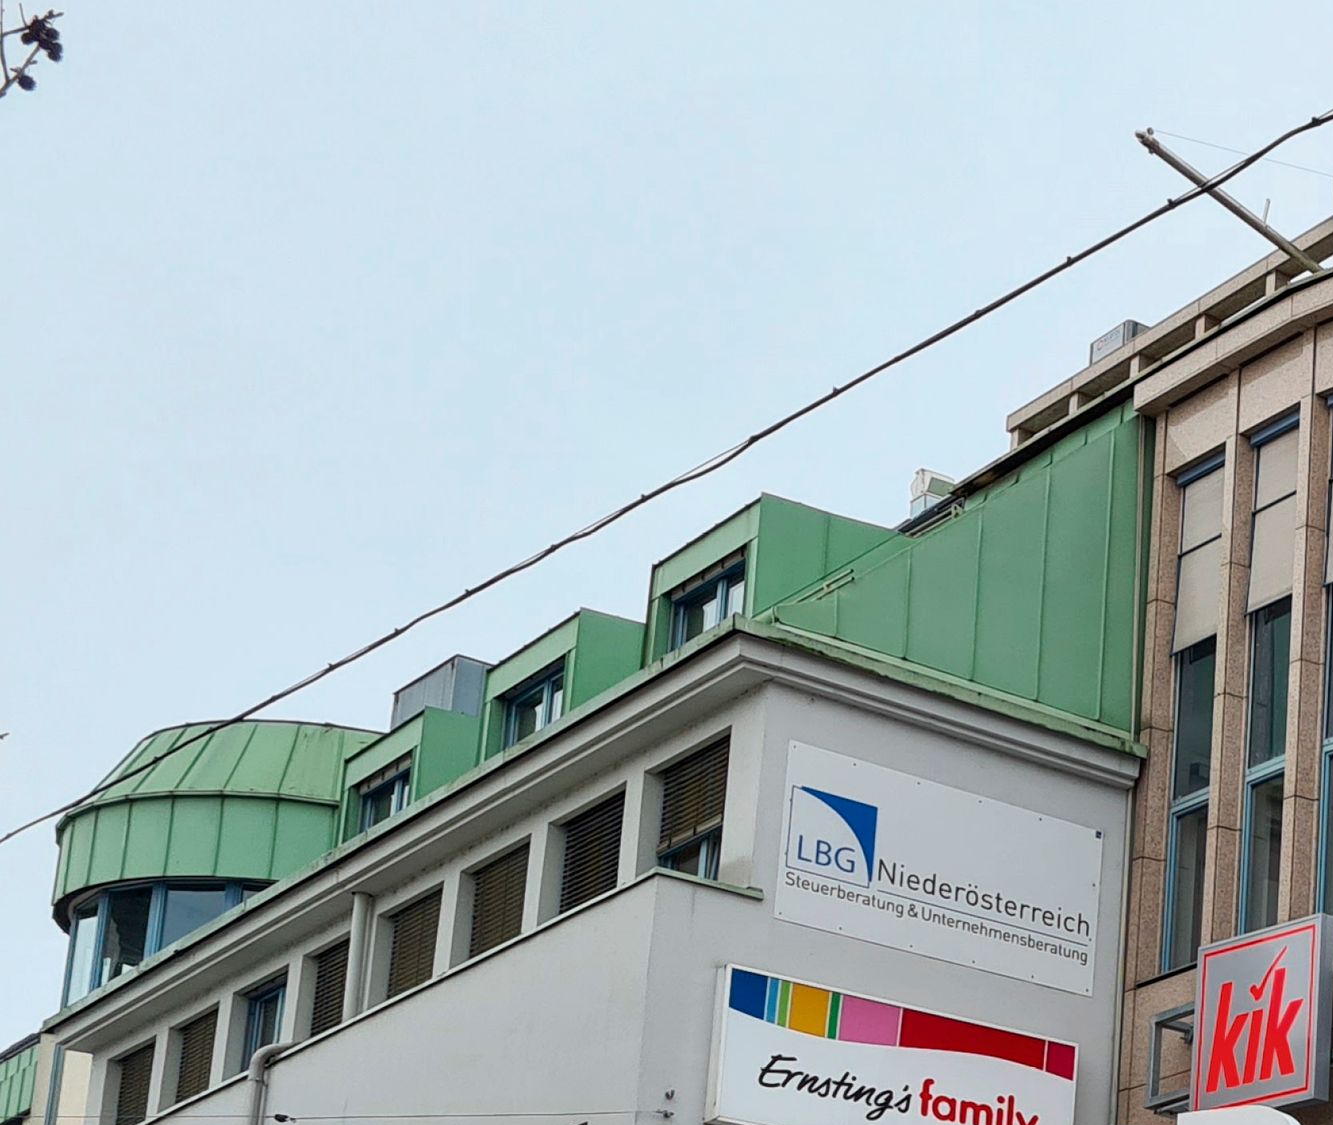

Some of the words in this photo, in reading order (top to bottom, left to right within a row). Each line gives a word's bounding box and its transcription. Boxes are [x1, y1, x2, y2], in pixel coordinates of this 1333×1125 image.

[797, 834, 856, 873] LBG
[785, 871, 905, 918] Steuerberatung
[907, 903, 919, 918] &
[921, 908, 1089, 966] Unternehmensberatung
[877, 859, 1090, 938] Niederösterreich
[1206, 946, 1304, 1094] kik
[759, 1054, 913, 1121] Ernsting's
